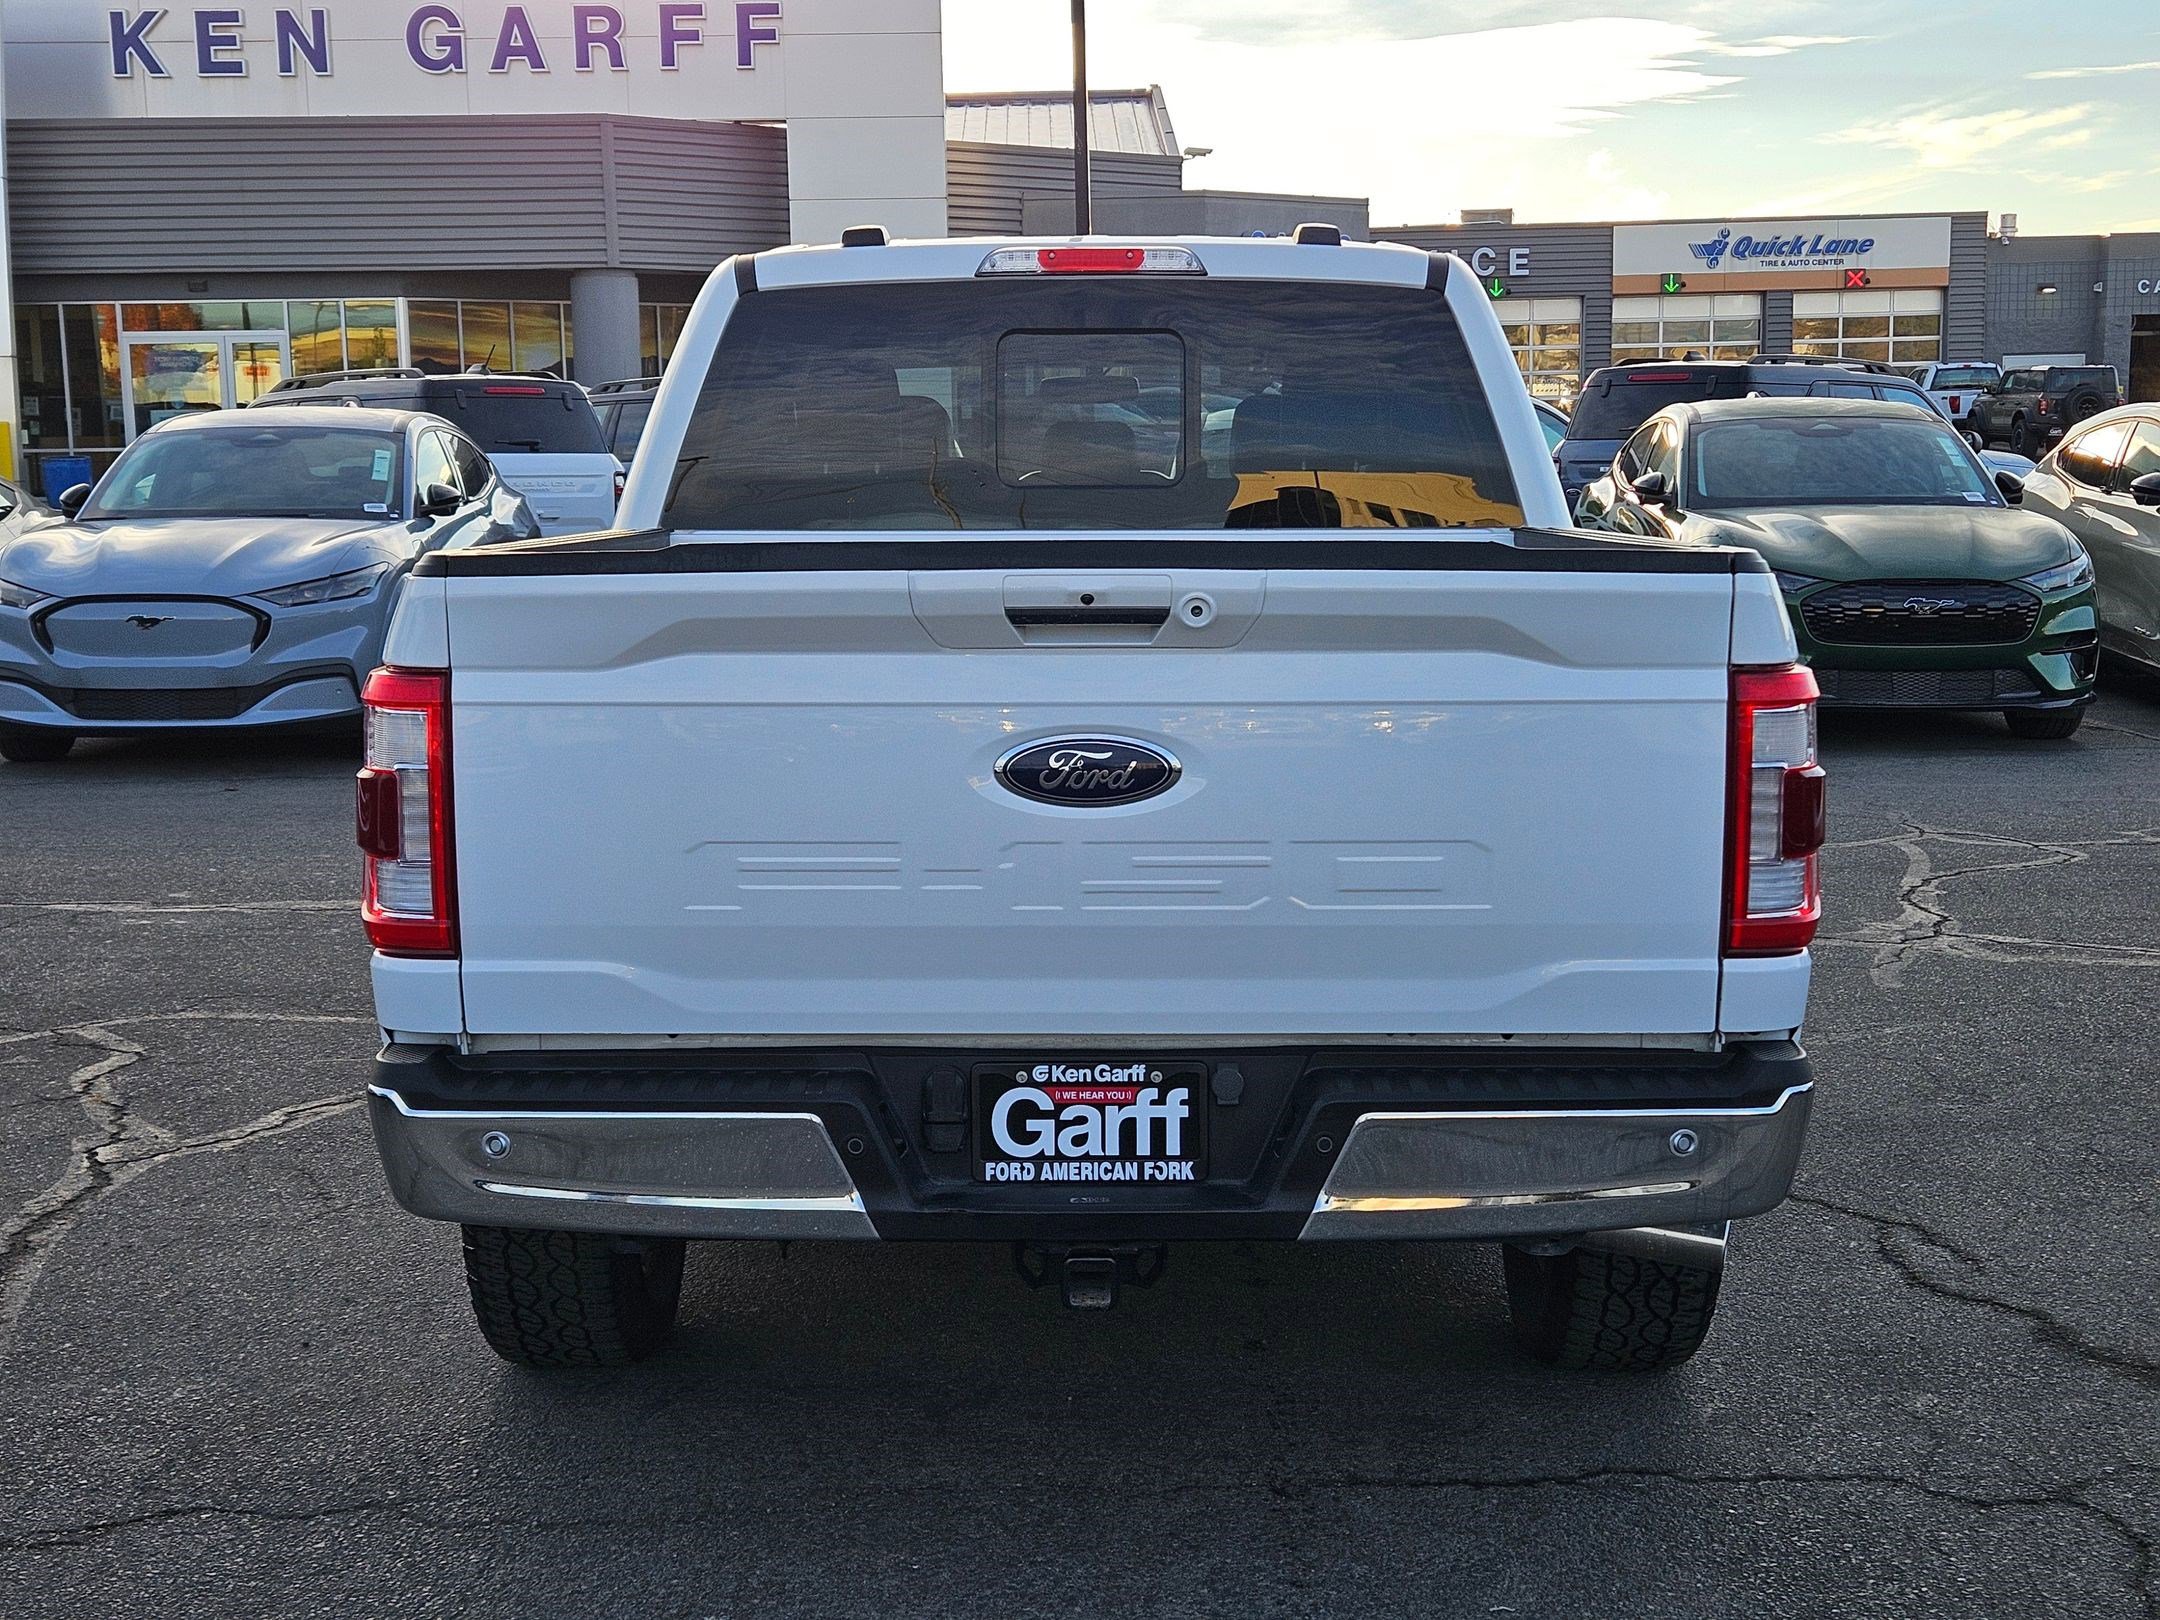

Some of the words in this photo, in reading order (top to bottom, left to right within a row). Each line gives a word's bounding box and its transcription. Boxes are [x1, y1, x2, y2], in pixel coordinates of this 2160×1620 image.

[109, 9, 333, 77] KEN
[404, 2, 783, 73] GARFF
[1731, 233, 1807, 259] Quick
[1808, 233, 1875, 256] Lane
[1039, 750, 1138, 790] Ford
[1051, 1065, 1092, 1082] Ken
[1094, 1064, 1146, 1082] Garff
[1062, 1091, 1077, 1099] WE
[1079, 1091, 1105, 1099] HEAR
[1106, 1091, 1125, 1099] YOU
[991, 1087, 1189, 1157] Garff
[985, 1161, 1035, 1181] FORD
[1040, 1161, 1138, 1181] AMERICAN
[1144, 1161, 1195, 1181] FORK
